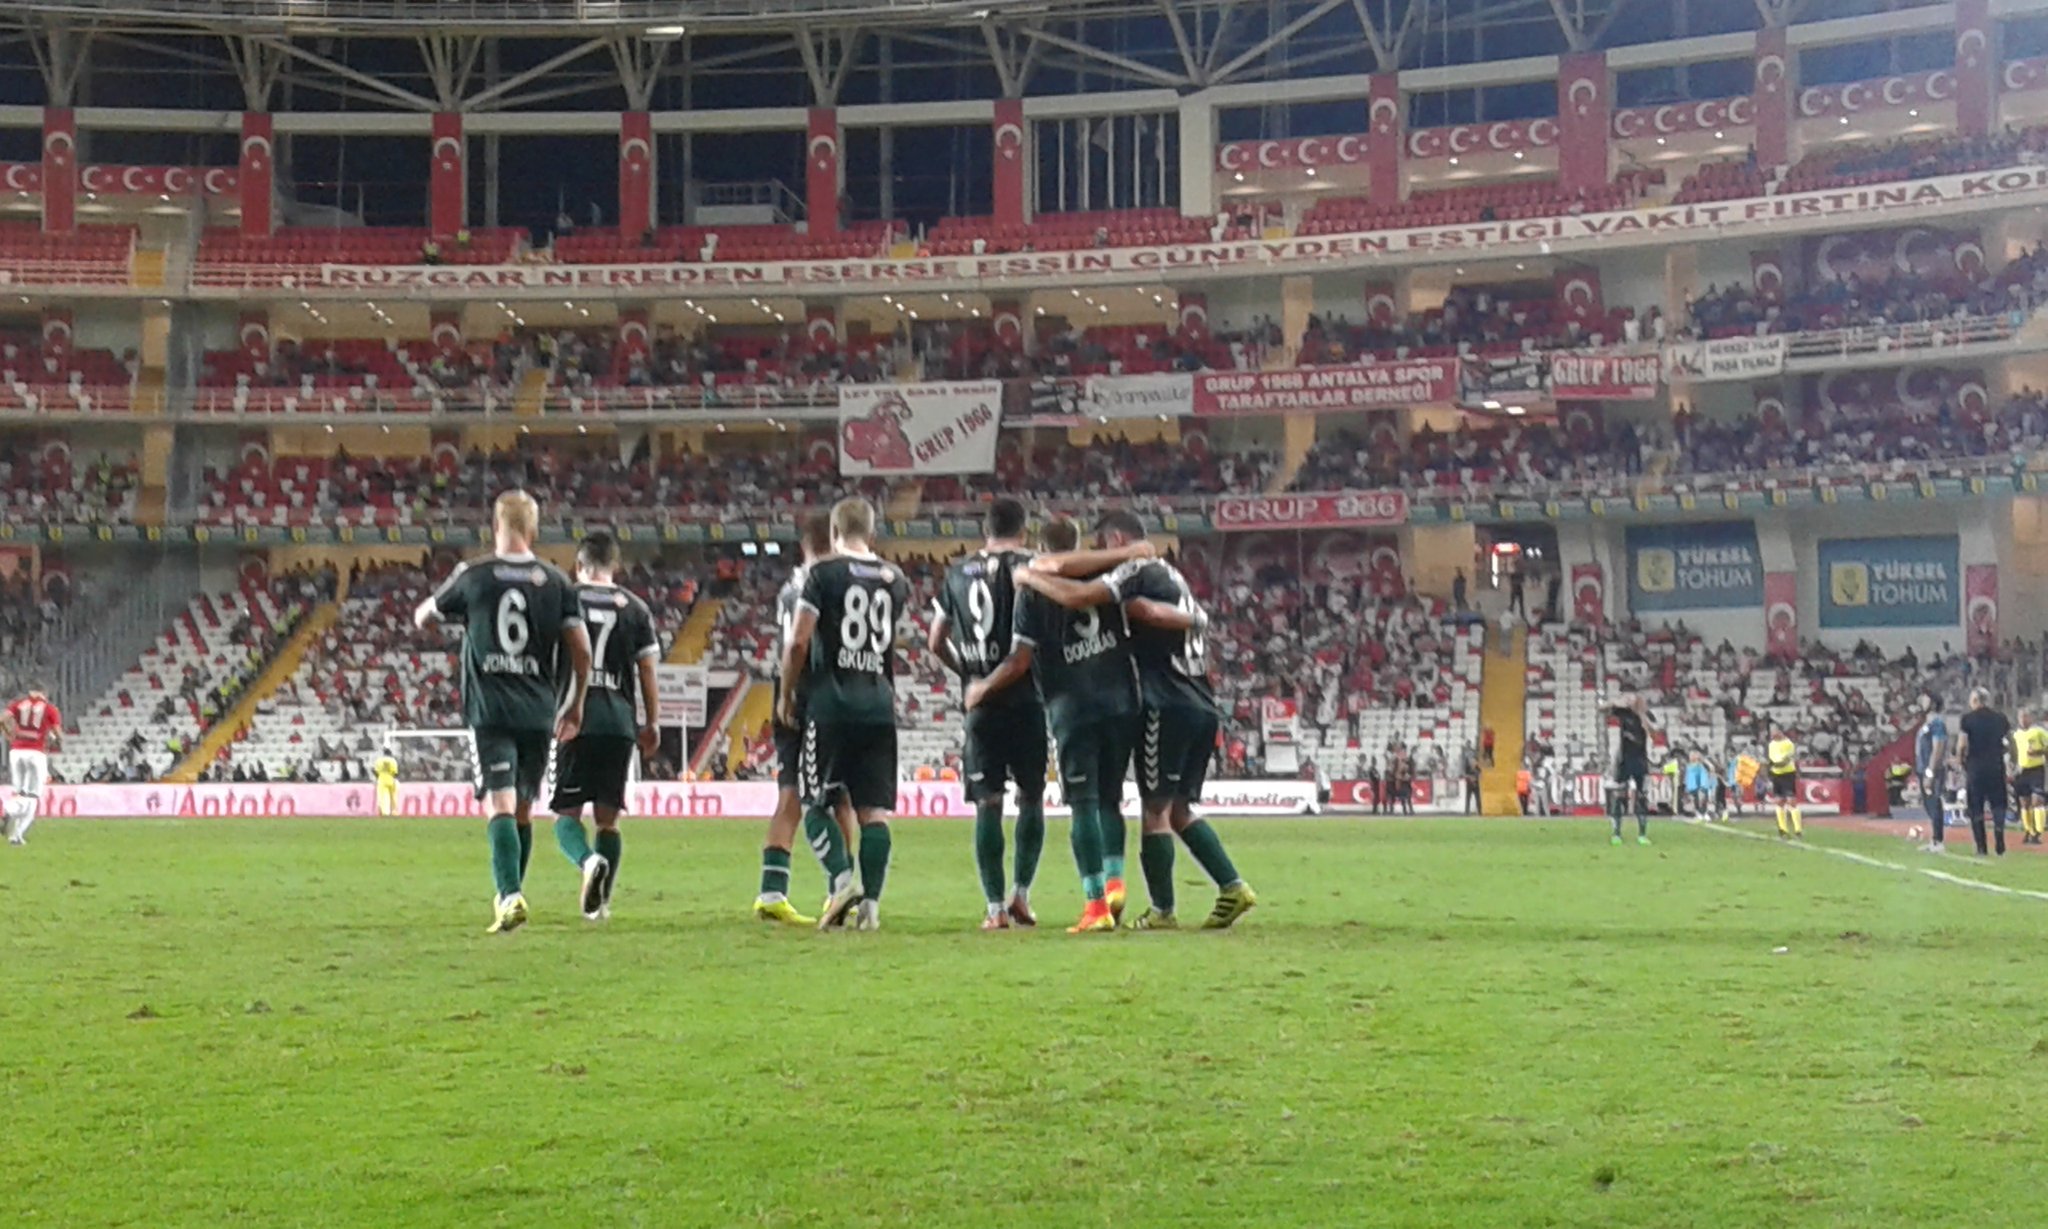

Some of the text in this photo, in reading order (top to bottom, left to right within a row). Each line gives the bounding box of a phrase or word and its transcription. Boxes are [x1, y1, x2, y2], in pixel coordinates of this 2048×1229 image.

[543, 265, 764, 286] NEREDEN
[1581, 205, 1730, 232] VAKİT
[1205, 376, 1256, 393] GRUP
[1307, 368, 1390, 388] ANTALYA
[1394, 365, 1443, 384] SPOR
[1553, 358, 1605, 385] GRUP
[1611, 357, 1659, 385] 1966
[1216, 389, 1348, 410] TARAFTARLAR
[915, 425, 955, 465] GRUP
[1221, 498, 1319, 522] GRUP
[1678, 544, 1752, 565] YÜKSEL
[1678, 566, 1753, 590] TOHUM
[1872, 560, 1947, 581] YÜKSEL
[1872, 582, 1948, 605] TOHUM
[497, 588, 529, 655] 6
[841, 584, 892, 654] 89
[968, 578, 994, 641] 9
[588, 608, 617, 670] 7
[1063, 629, 1117, 664] DOUGLAS
[17, 699, 47, 729] 11
